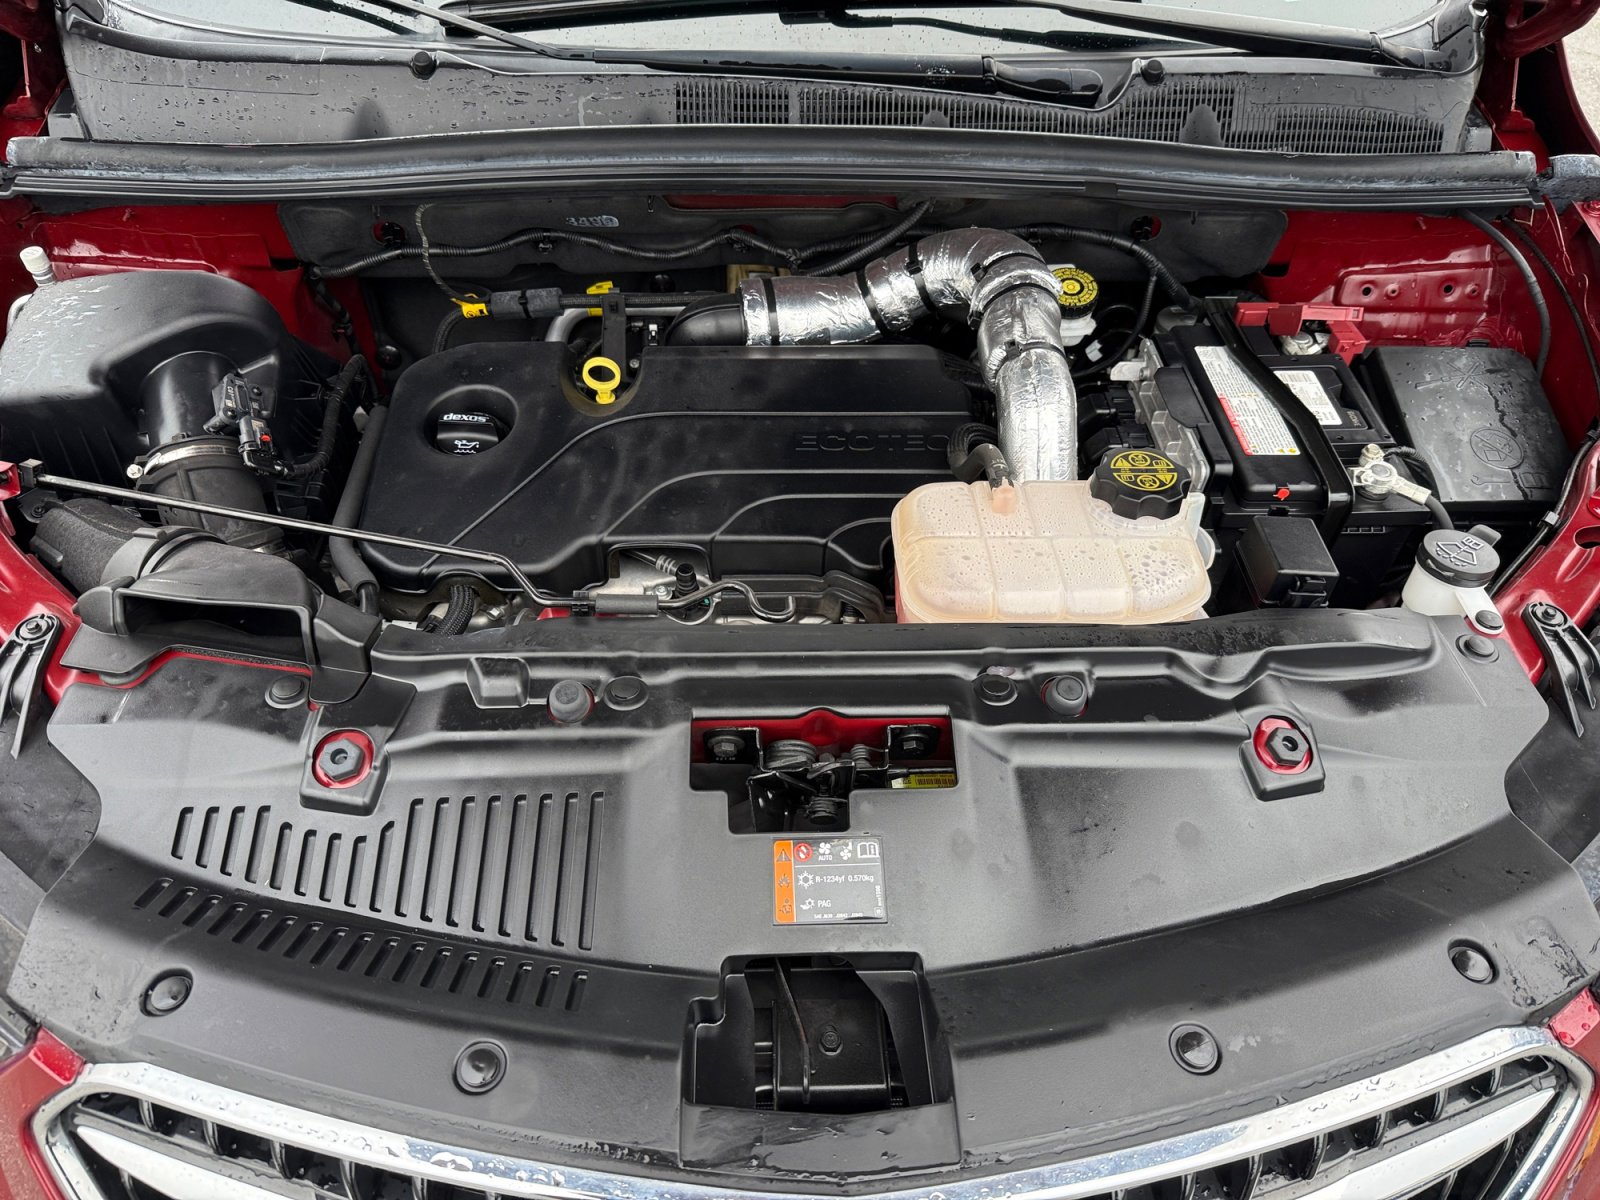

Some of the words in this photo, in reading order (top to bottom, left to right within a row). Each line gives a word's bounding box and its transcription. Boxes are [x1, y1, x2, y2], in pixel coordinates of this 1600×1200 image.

[443, 413, 488, 422] dexos
[795, 434, 950, 451] ECOTEC
[815, 874, 846, 884] R-1234yf
[847, 875, 875, 883] 0.570kg
[817, 900, 832, 908] PAG
